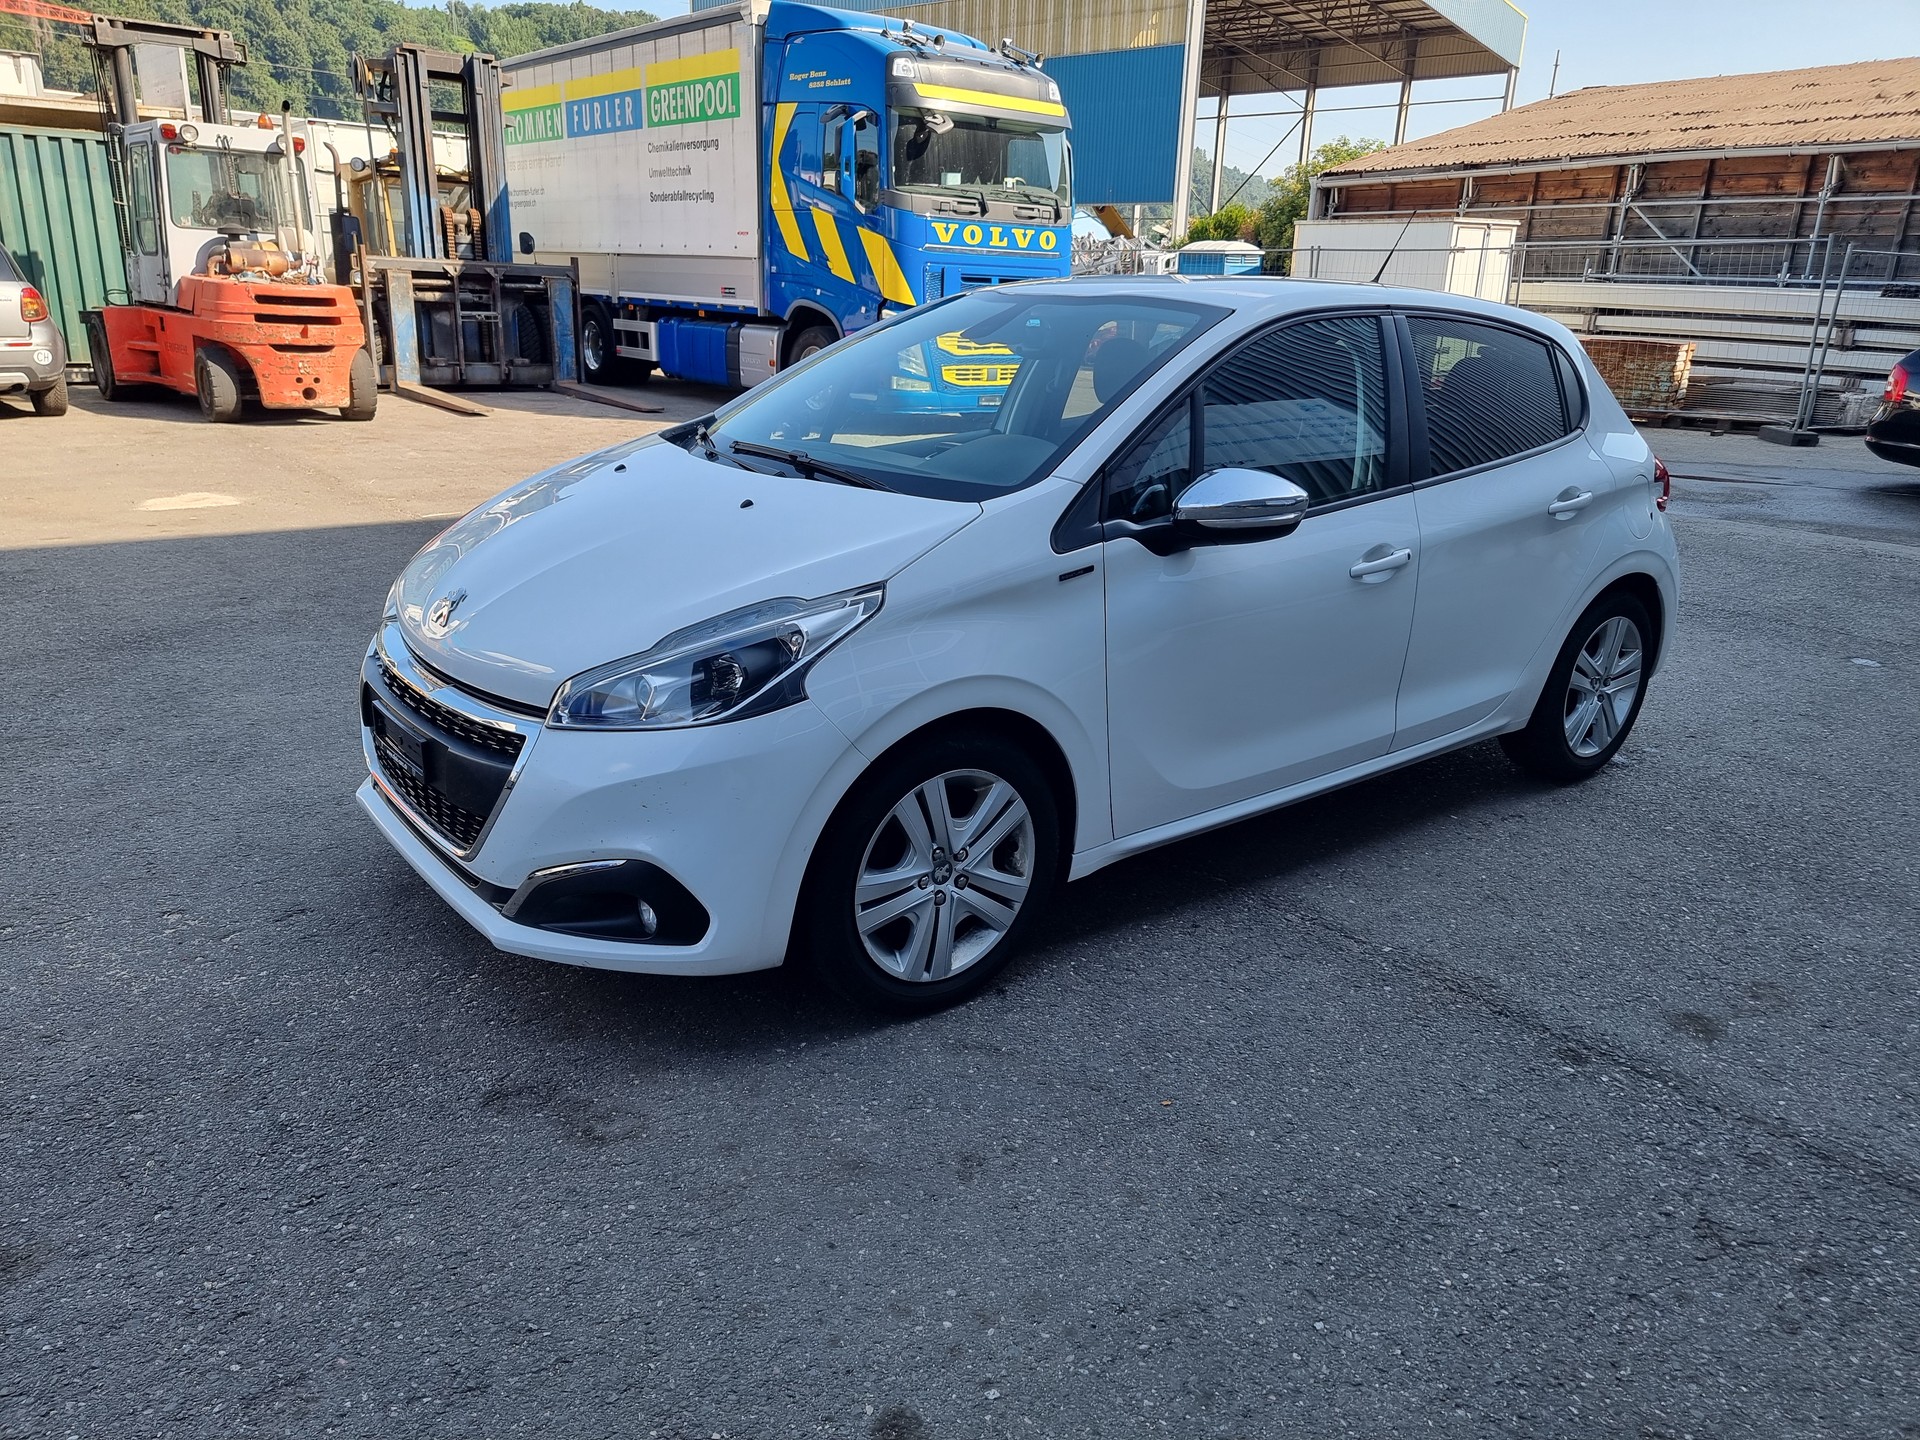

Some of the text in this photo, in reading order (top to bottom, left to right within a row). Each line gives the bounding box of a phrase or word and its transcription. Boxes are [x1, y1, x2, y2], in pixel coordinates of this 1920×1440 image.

[789, 71, 827, 81] Roger Benz
[825, 78, 851, 87] Schlatt
[651, 78, 736, 123] GREENPOOL
[573, 96, 634, 132] FURLER
[647, 139, 719, 153] Chemikalienversorgung
[648, 165, 692, 178] Umwelttechnik
[649, 189, 715, 204] Sonderabfallrecycling
[931, 222, 1057, 250] VOLVO
[36, 351, 50, 362] CH
